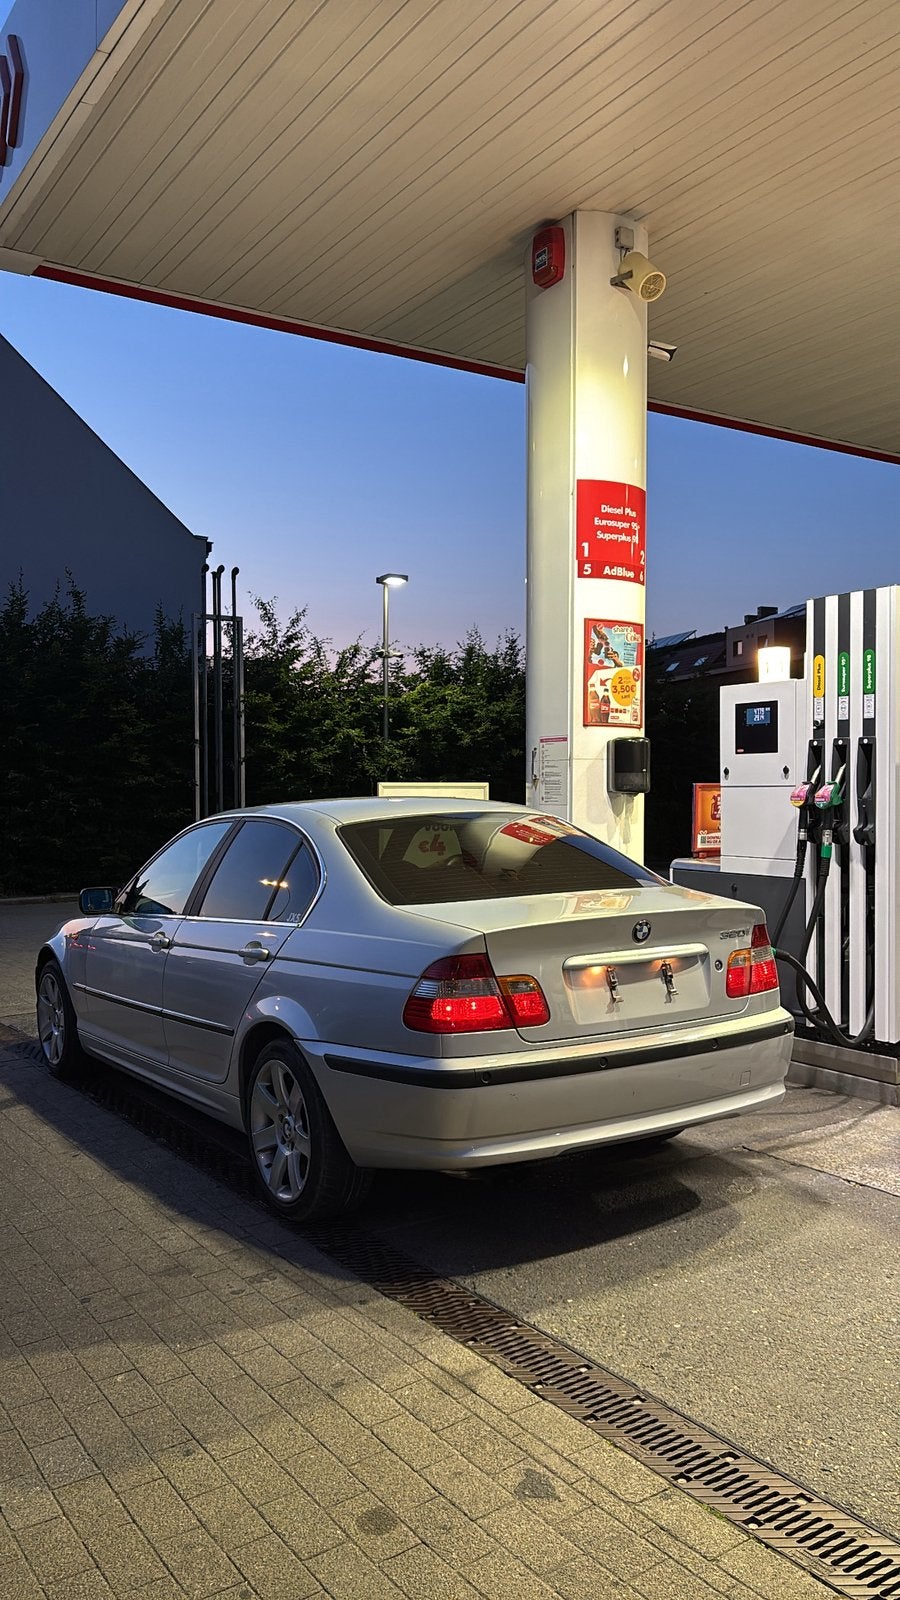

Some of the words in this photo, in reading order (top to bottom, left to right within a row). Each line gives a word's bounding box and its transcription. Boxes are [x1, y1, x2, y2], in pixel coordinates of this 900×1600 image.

[601, 504, 623, 515] Diesel
[625, 507, 636, 517] Plus
[594, 517, 630, 529] Eurosuper
[596, 530, 631, 542] Superplus
[581, 542, 589, 557] 1
[640, 550, 645, 565] 2
[583, 564, 592, 575] 5
[603, 566, 635, 578] AdBlue
[639, 571, 644, 581] 6
